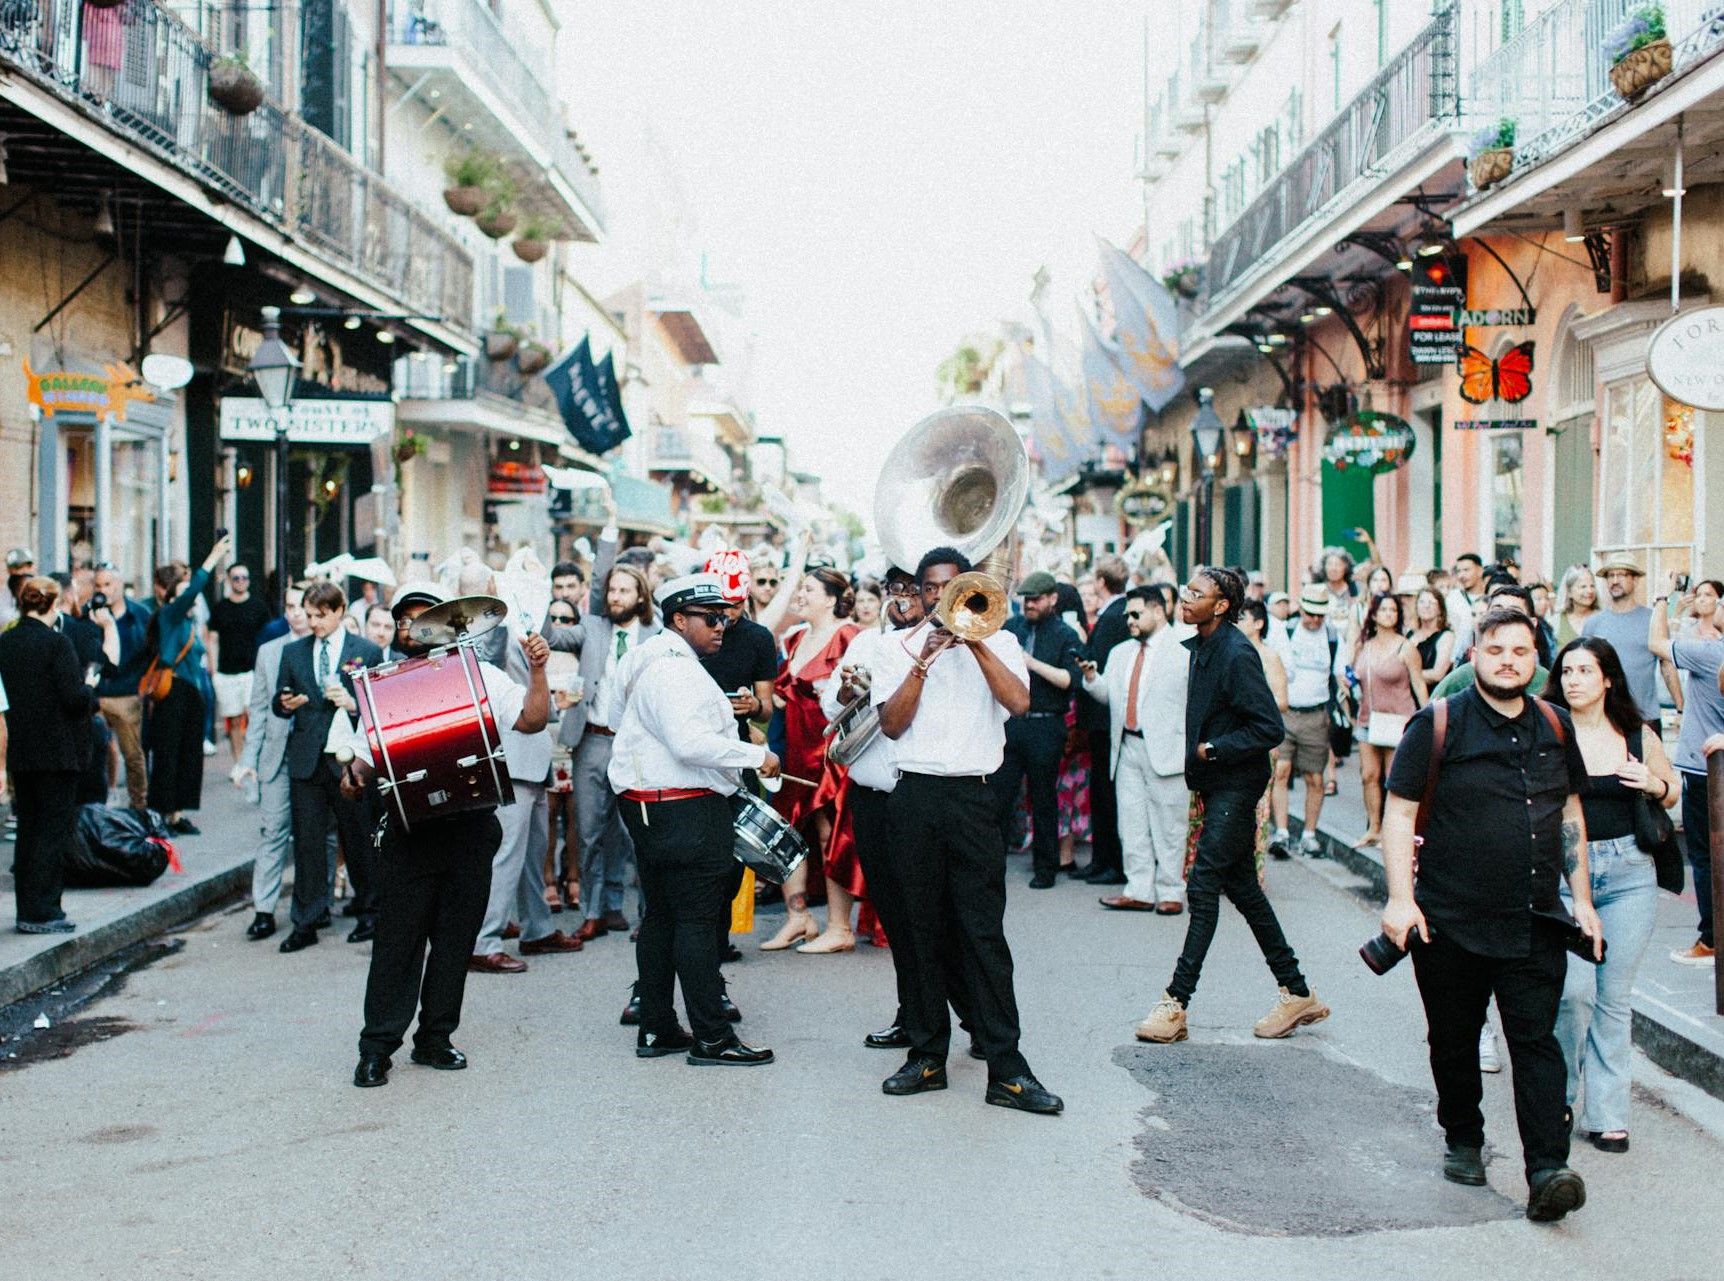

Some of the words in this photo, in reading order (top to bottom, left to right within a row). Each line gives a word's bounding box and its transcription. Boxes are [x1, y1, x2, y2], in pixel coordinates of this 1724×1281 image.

[1459, 309, 1528, 327] ADORN
[1412, 331, 1434, 342] FOR
[231, 416, 278, 431] TWO
[289, 418, 382, 434] SISTERS
